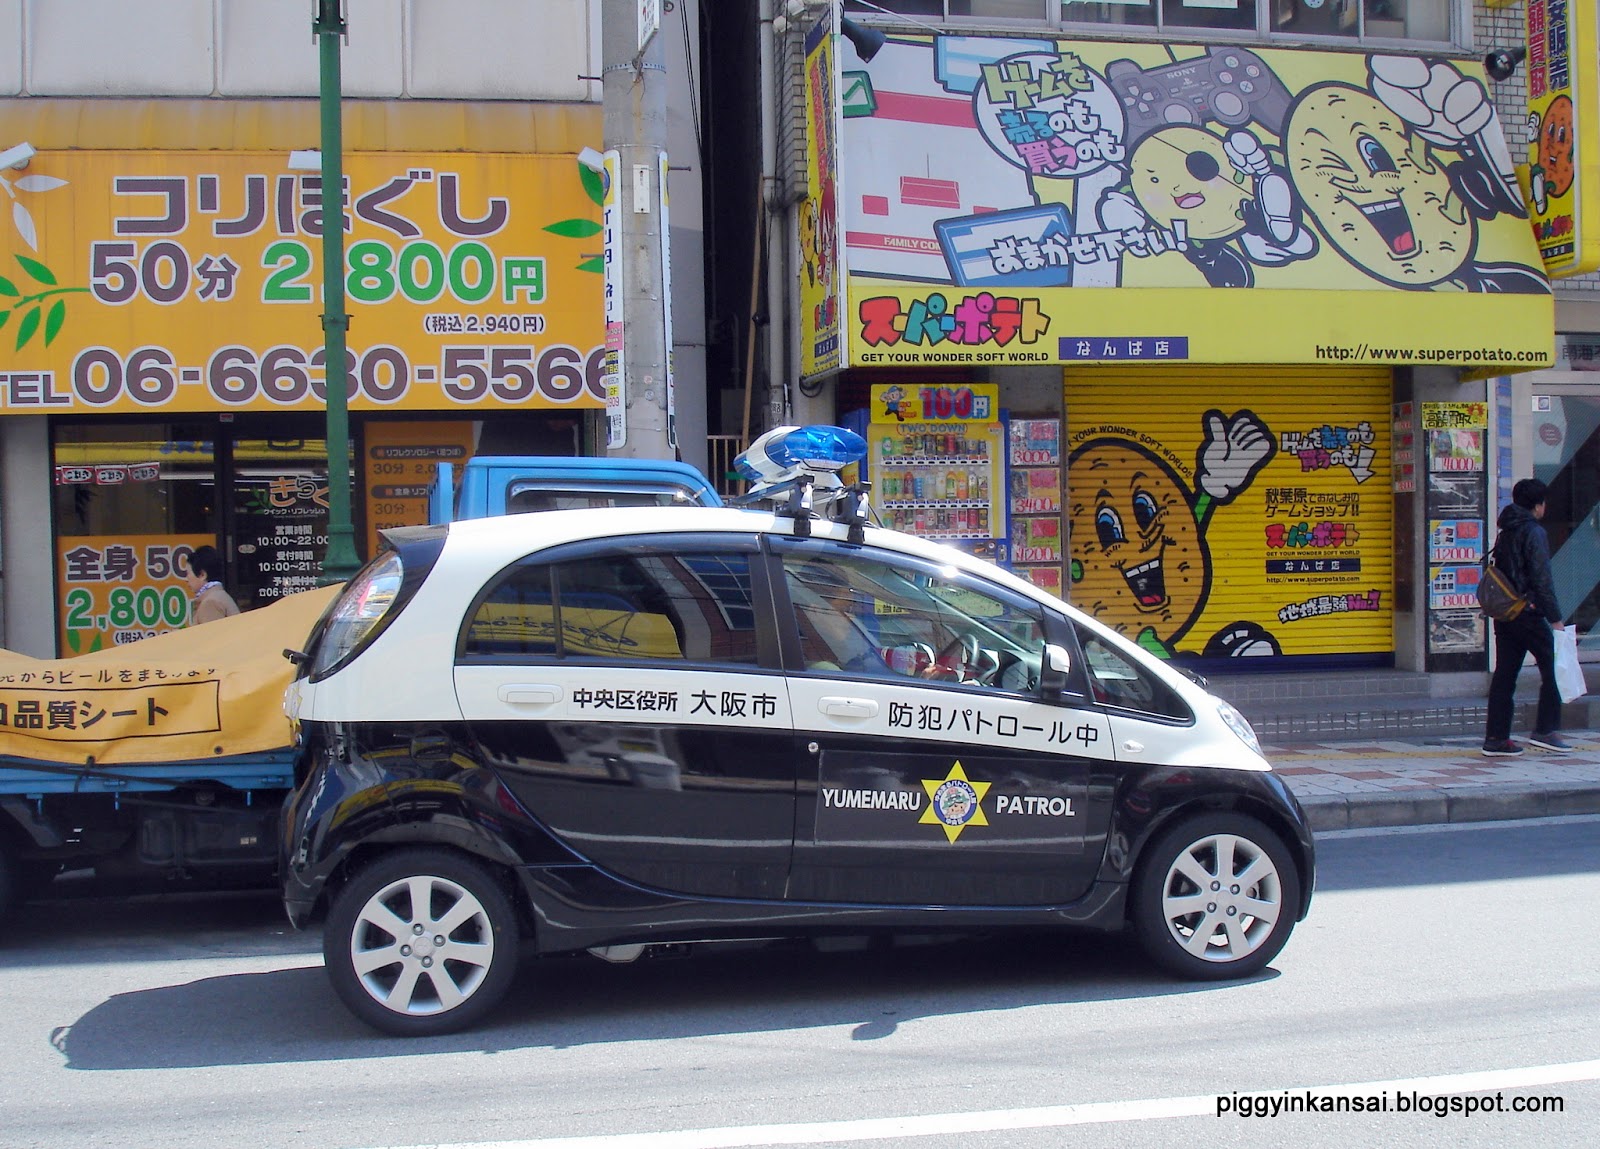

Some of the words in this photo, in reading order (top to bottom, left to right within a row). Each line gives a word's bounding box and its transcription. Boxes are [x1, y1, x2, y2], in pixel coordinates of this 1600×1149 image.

[980, 52, 1094, 108] ゲームを
[1166, 67, 1196, 79] SONY
[996, 99, 1102, 143] 売るのも
[1016, 129, 1126, 174] 買うのも
[114, 170, 509, 239] コリほぐし
[884, 237, 919, 249] FAMILY
[988, 218, 1189, 275] おまかせ下さい!
[90, 241, 238, 302] 50分
[261, 240, 546, 302] 2800円
[859, 291, 1051, 347] スーパーポテト
[861, 353, 884, 362] GET
[887, 353, 920, 362] YOUR
[922, 353, 974, 362] WONDER
[976, 353, 1006, 362] SOFT
[1007, 352, 1049, 362] WORLD
[1077, 340, 1169, 356] なんば店
[1315, 343, 1549, 363] http://www.superpotato.com
[0, 372, 73, 406] EL
[919, 387, 990, 419] 100円
[900, 423, 926, 433] TWO
[930, 423, 966, 434] DOWN
[1072, 427, 1097, 442] YOUR
[1099, 425, 1138, 438] WONDER
[1139, 433, 1163, 449] SOFT
[373, 463, 404, 475] 30分
[375, 504, 405, 515] 30分
[1265, 488, 1359, 504] 秋葉原でおなじみの
[275, 525, 313, 536] 営業時間
[1265, 521, 1360, 549] スーパーポテト
[66, 545, 138, 581] 全身
[276, 551, 314, 561] 受付時間
[1285, 561, 1340, 571] なんば店
[67, 586, 196, 630] 2,800
[573, 688, 678, 712] 中央区役所
[690, 689, 778, 719] 大阪市
[888, 701, 1099, 748] 防犯パトロール中
[822, 788, 921, 811] YUMEMARU
[996, 796, 1076, 816] PATROL
